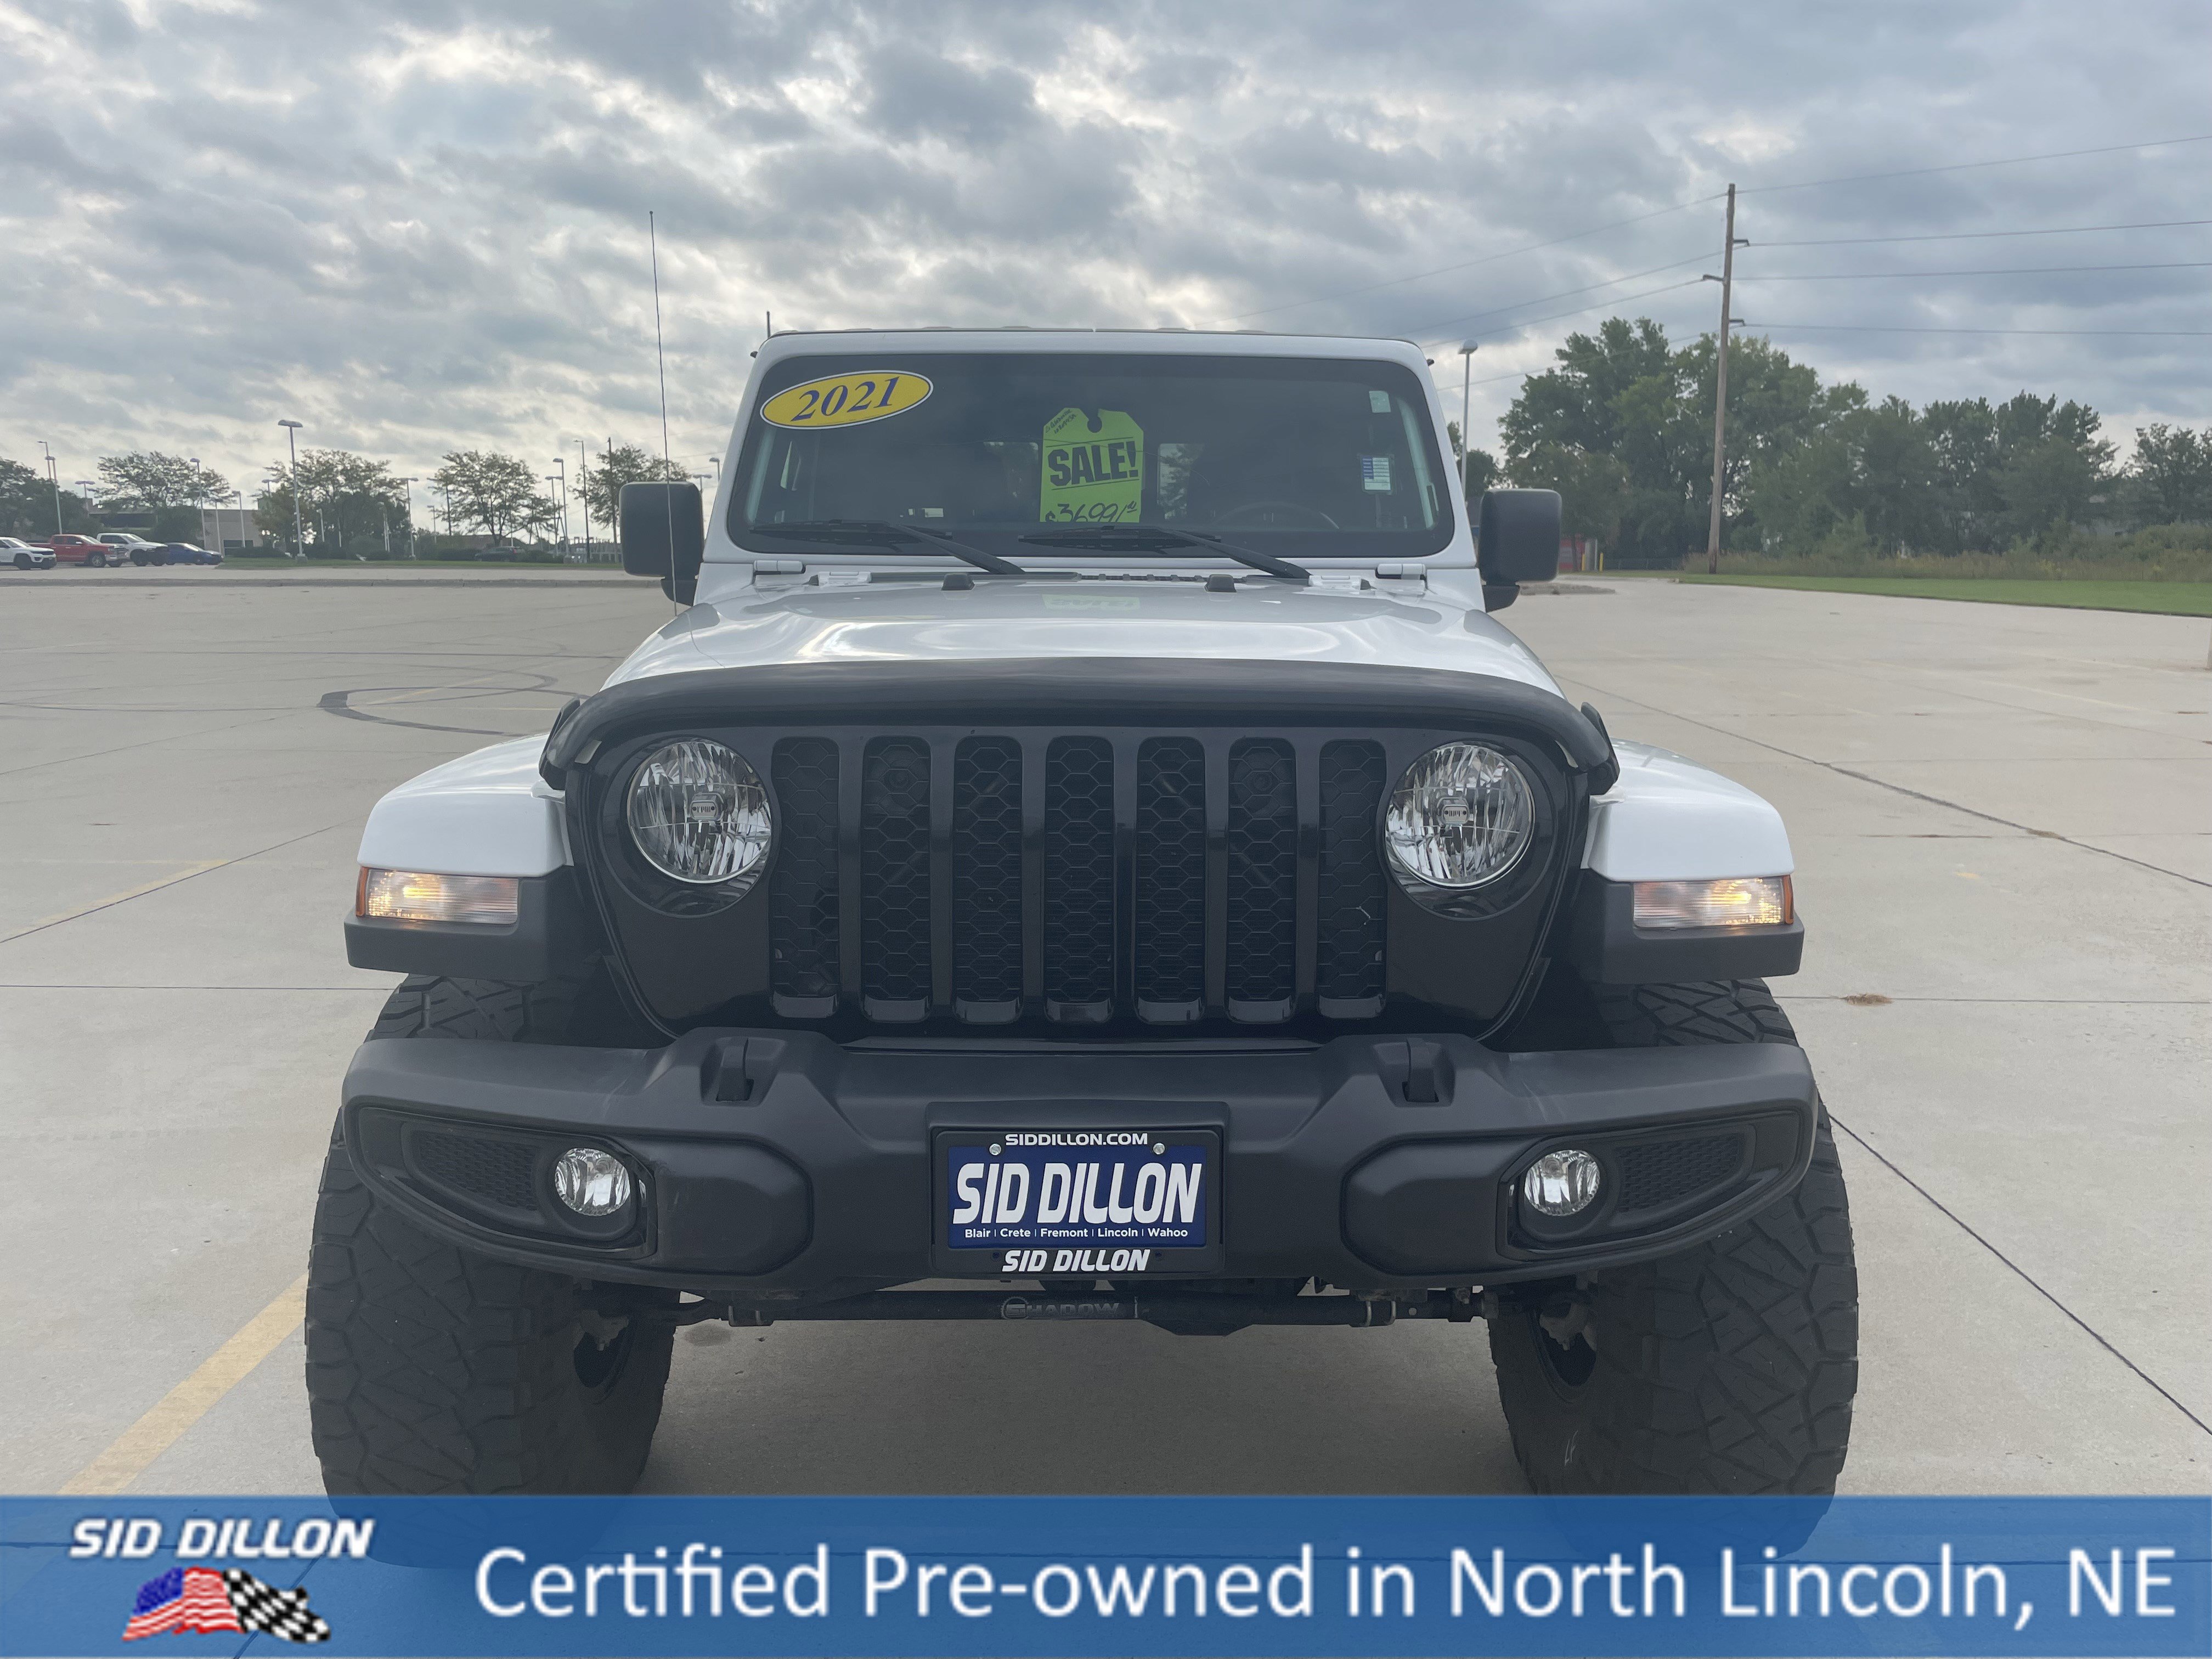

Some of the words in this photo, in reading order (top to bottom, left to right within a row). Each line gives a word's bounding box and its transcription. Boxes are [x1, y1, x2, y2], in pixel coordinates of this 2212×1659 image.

[790, 376, 900, 422] 2021
[1047, 441, 1138, 487] SALE!
[1005, 1133, 1148, 1146] SIDDILLON.COM
[952, 1163, 1030, 1224] SID
[1037, 1163, 1202, 1224] DILLON
[965, 1228, 991, 1238] Blair
[1000, 1228, 1031, 1237] Crete
[1040, 1228, 1088, 1237] Fremont
[1098, 1227, 1138, 1237] Lincoln
[1147, 1227, 1188, 1237] Wahoo
[1002, 1250, 1047, 1272] SID
[1052, 1249, 1150, 1272] DILLON
